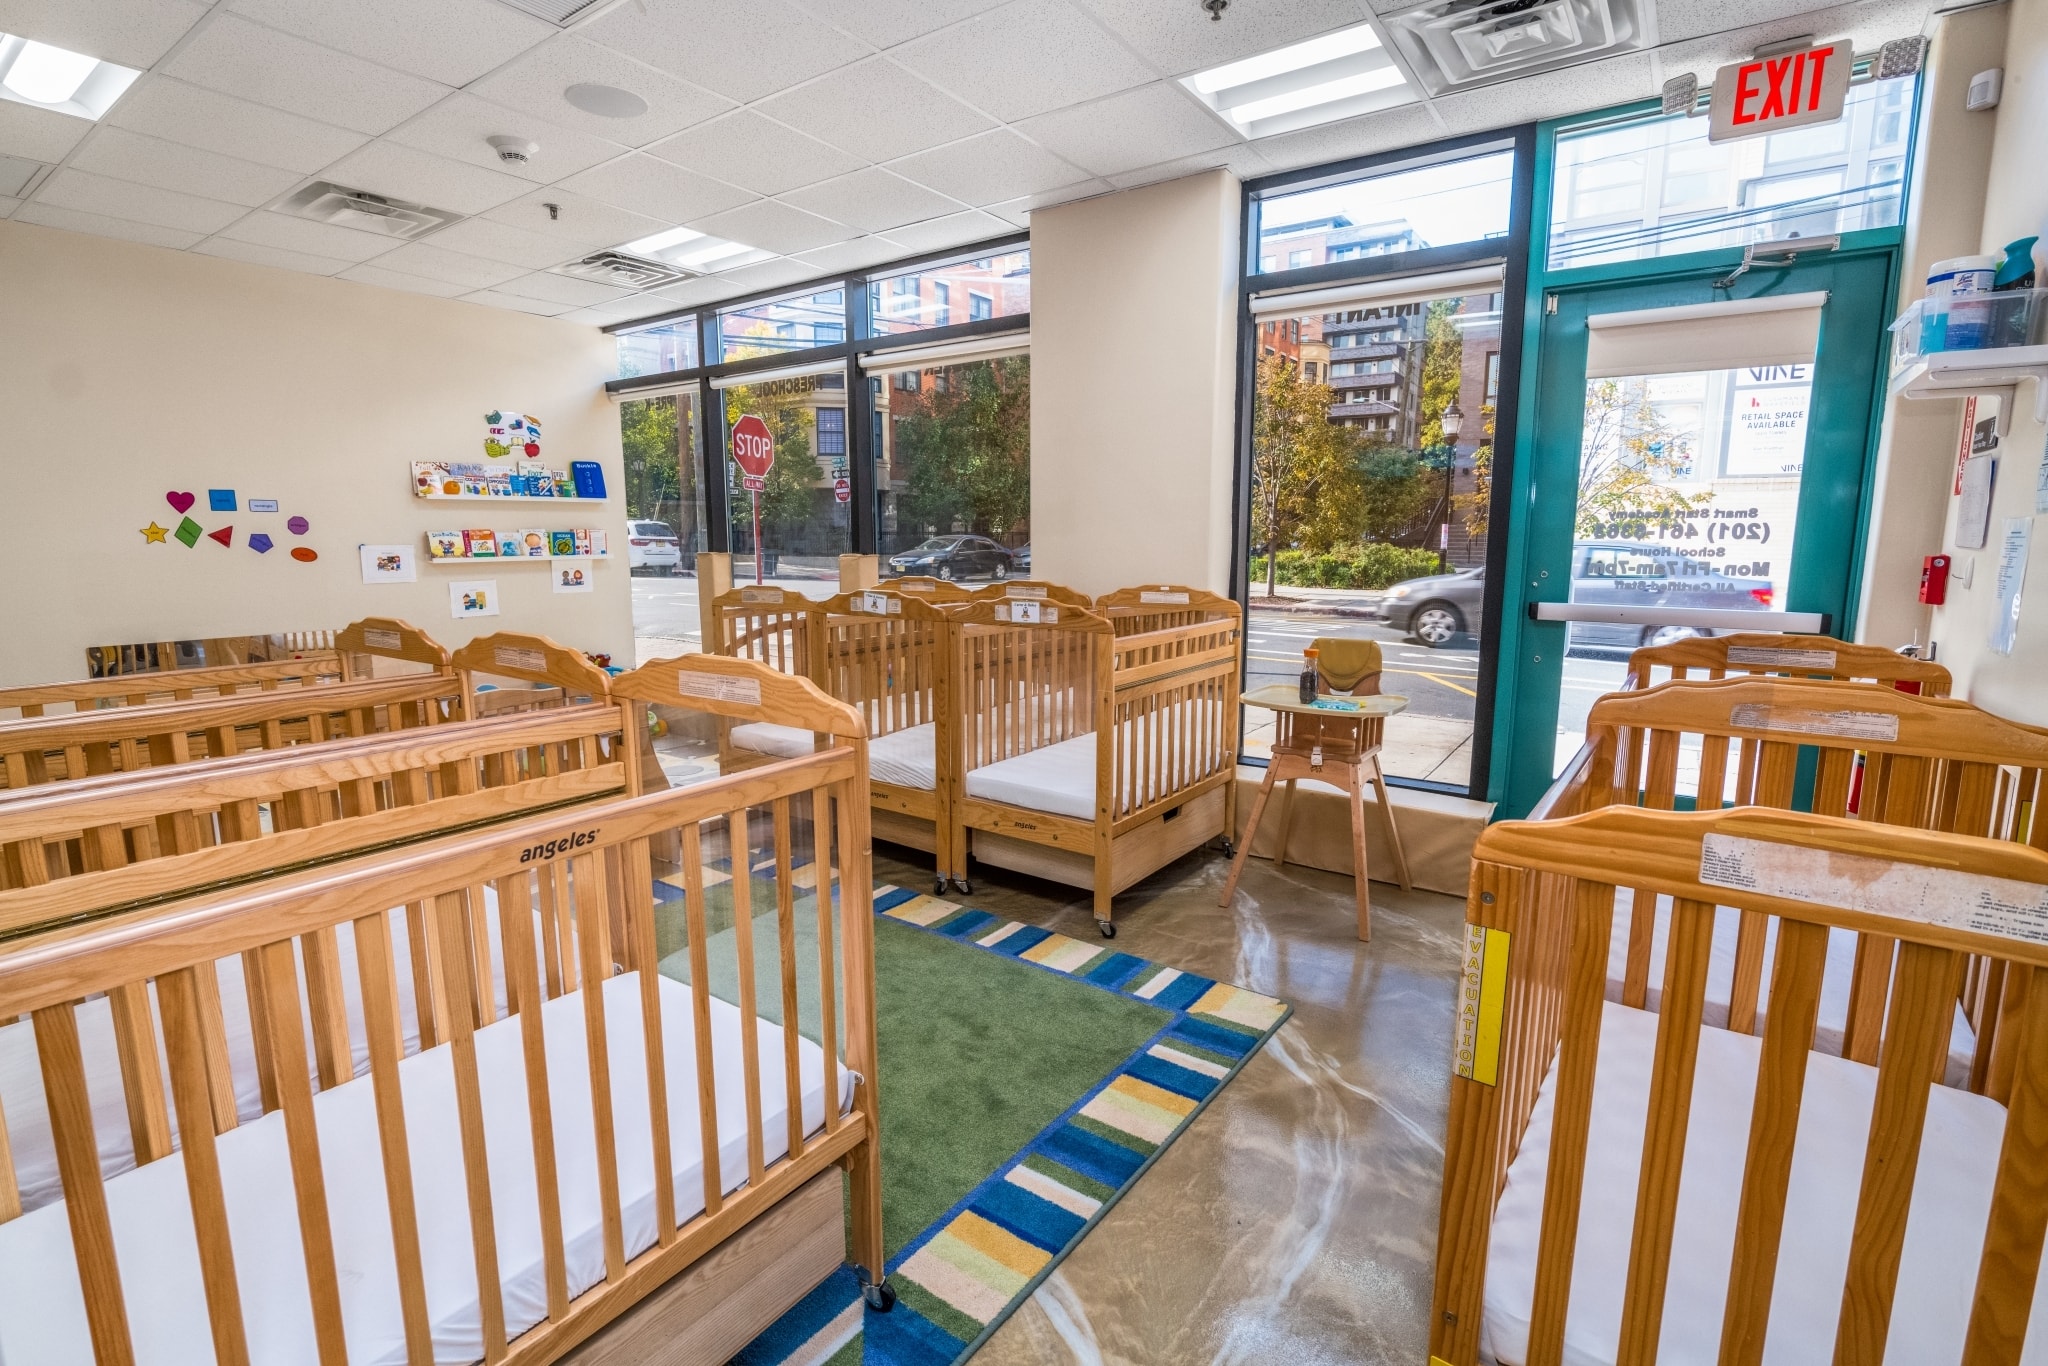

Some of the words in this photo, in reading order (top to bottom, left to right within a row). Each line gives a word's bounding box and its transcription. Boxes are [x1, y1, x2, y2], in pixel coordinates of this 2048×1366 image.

[1732, 46, 1835, 126] EXIT
[1749, 363, 1806, 382] VINE
[1741, 413, 1772, 421] RETAIL
[1775, 411, 1805, 419] SPACE
[1747, 420, 1797, 429] AVAILABLE
[736, 433, 771, 459] STOP
[1780, 464, 1804, 473] VINE
[520, 829, 597, 863] angeles
[1458, 925, 1482, 1077] EVACUATION
